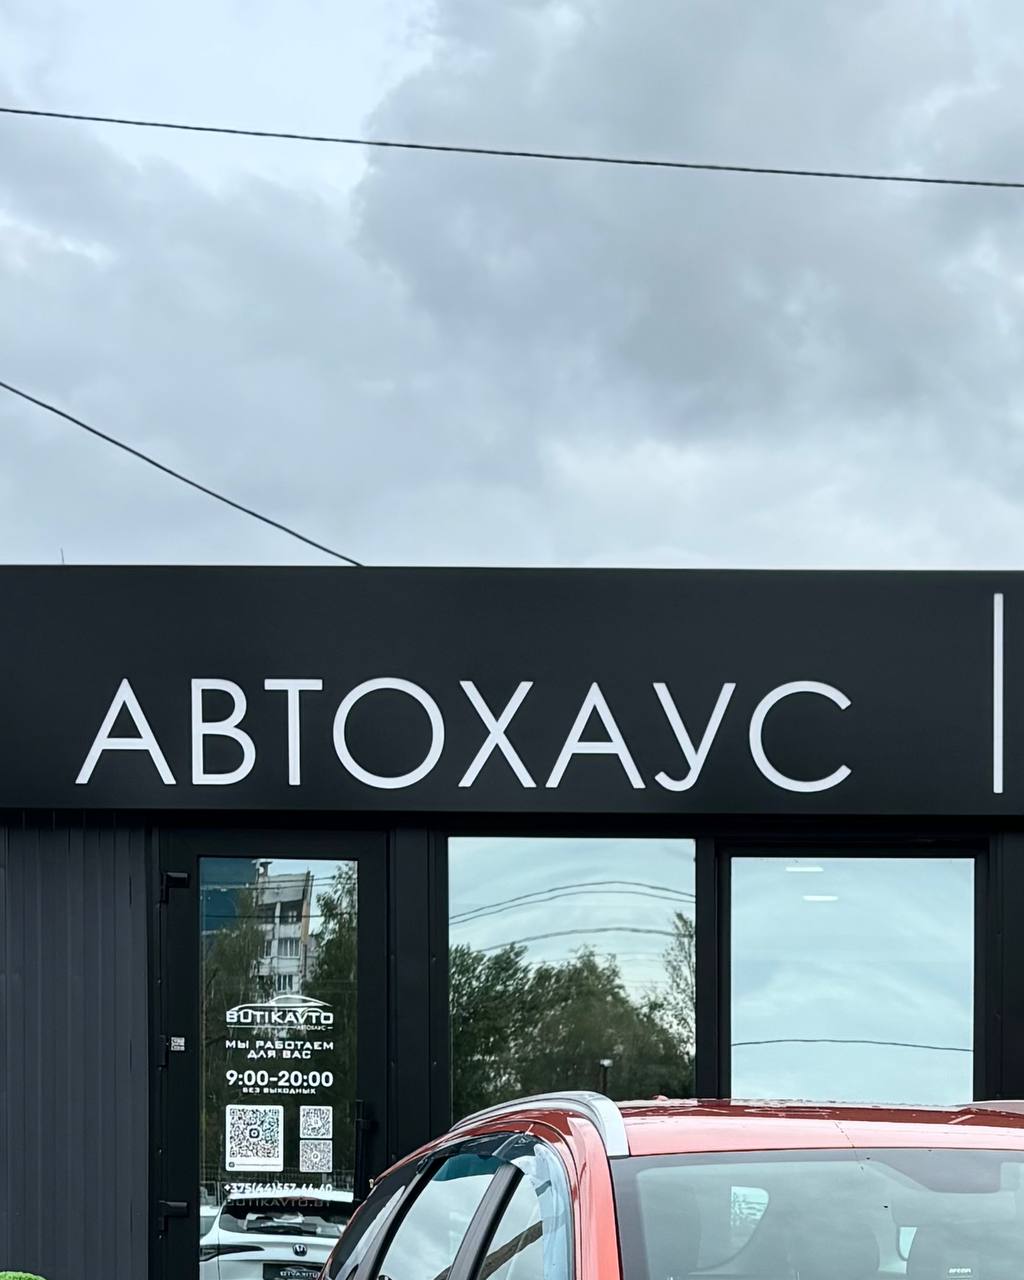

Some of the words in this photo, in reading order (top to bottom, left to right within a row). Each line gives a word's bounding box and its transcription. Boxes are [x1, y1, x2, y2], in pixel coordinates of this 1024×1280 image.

[75, 676, 853, 793] АВТОХАУС
[225, 1009, 334, 1025] BUTIKAVTO
[225, 1040, 250, 1049] МЫ
[255, 1040, 334, 1050] РАБОТАЕМ
[247, 1050, 276, 1059] ДЛЯ
[282, 1050, 312, 1059] ВАС
[225, 1070, 334, 1087] 9:00-20:00
